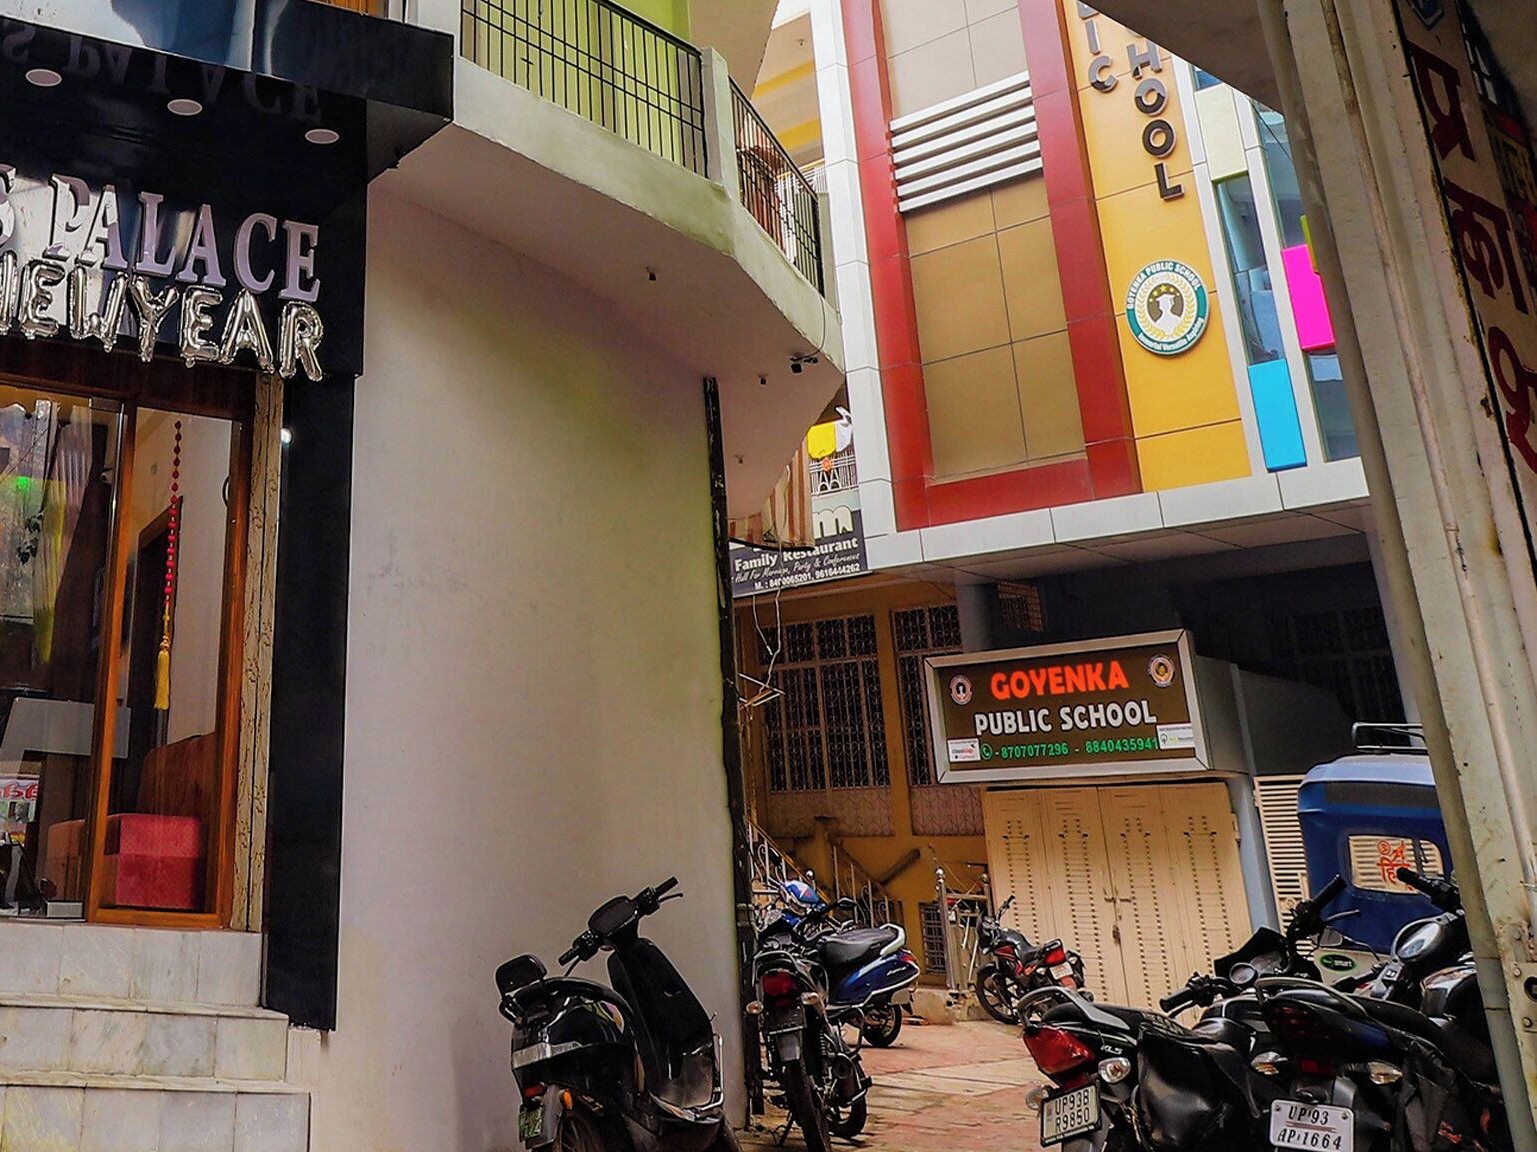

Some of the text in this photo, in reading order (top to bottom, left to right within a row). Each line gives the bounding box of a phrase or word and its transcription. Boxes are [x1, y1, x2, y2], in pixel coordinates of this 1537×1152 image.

[1126, 38, 1185, 200] HOOL
[43, 172, 321, 303] PALACE
[1145, 262, 1174, 276] PUBLIC
[1174, 263, 1202, 291] SCHOOL
[130, 273, 326, 383] YEAR
[734, 553, 778, 572] Family
[990, 660, 1130, 700] GOYENKA
[974, 700, 1158, 736] PUBLIC SCHOOL
[1085, 736, 1159, 754] 8840435941
[1055, 1107, 1089, 1134] R9850
